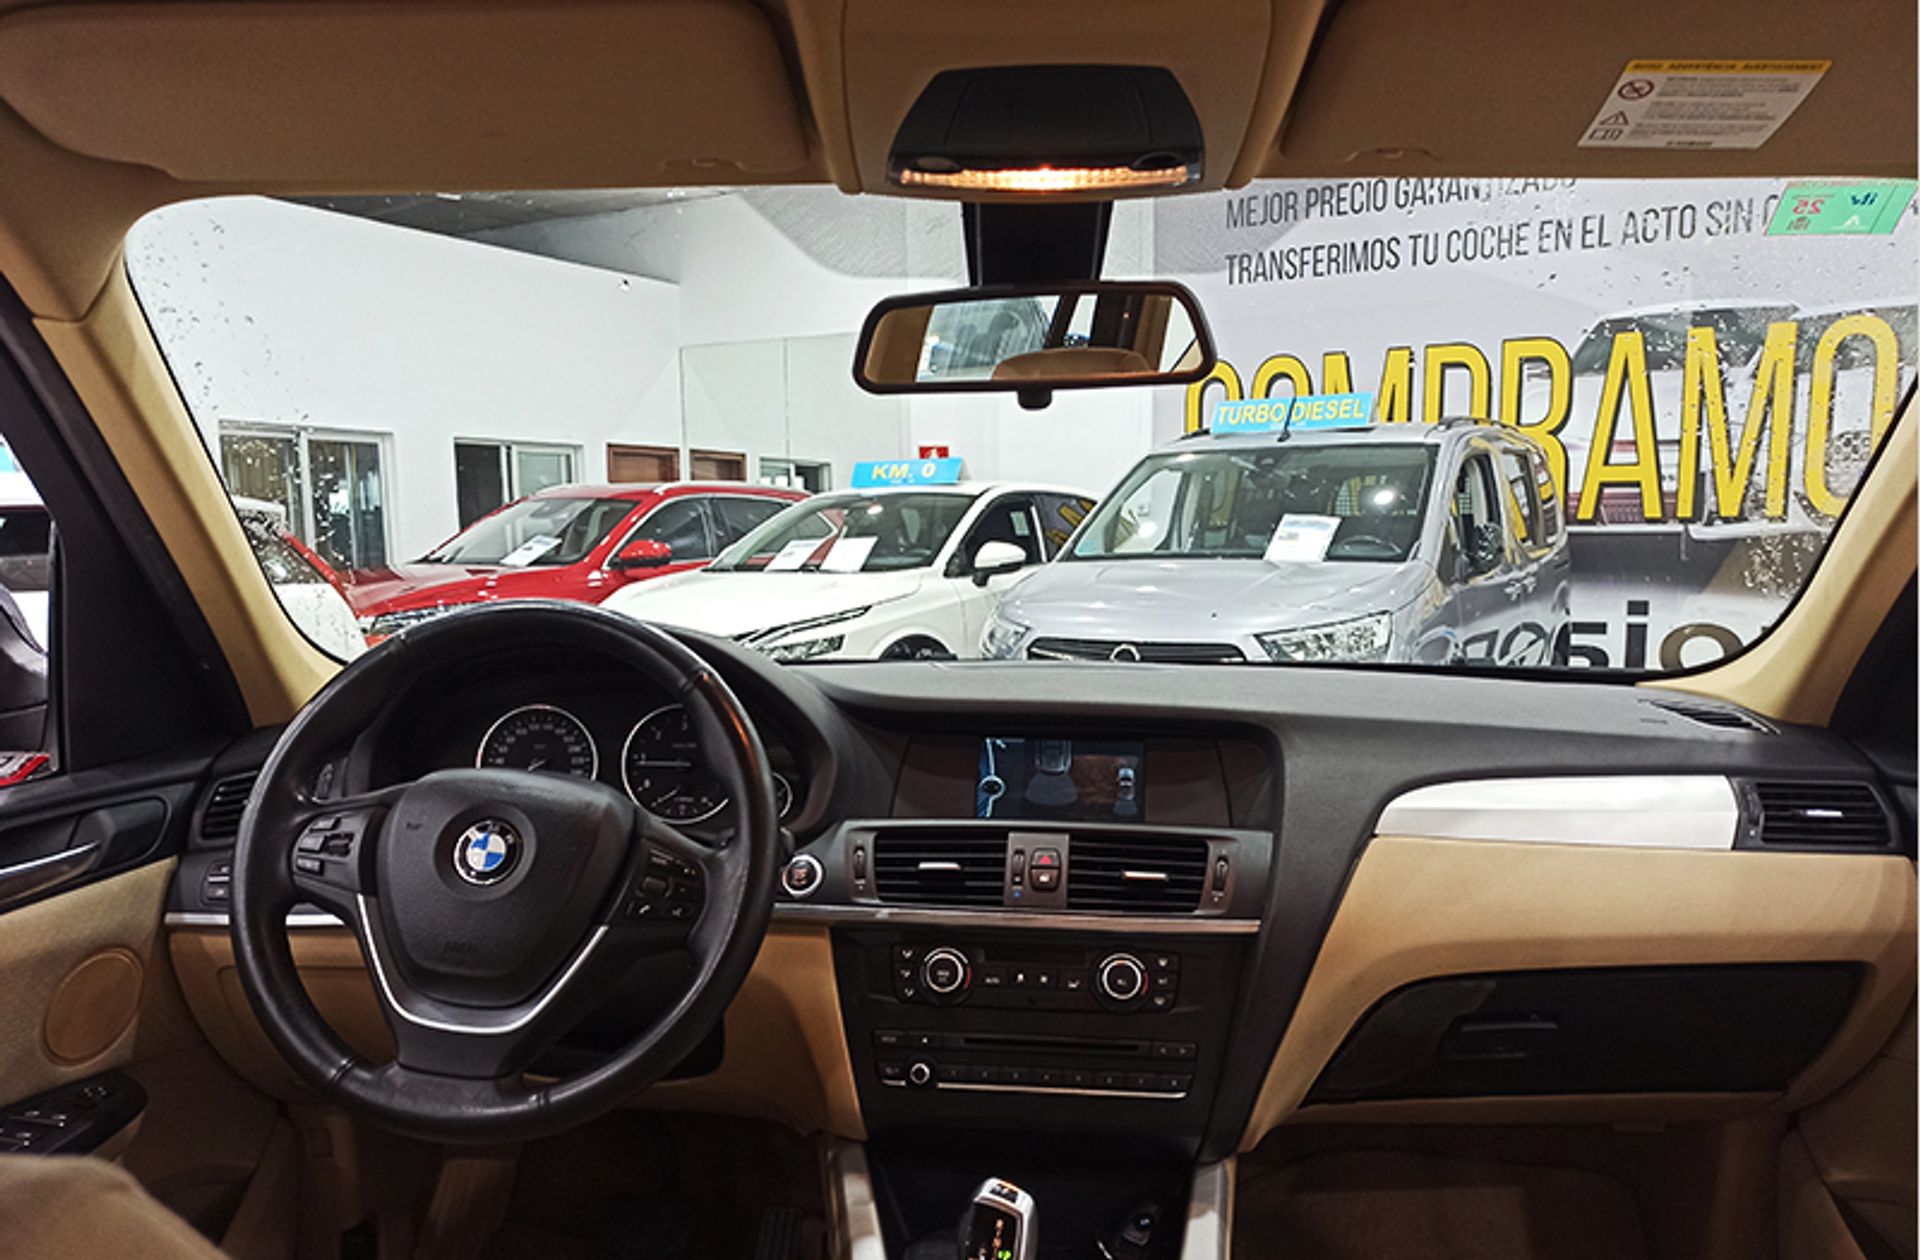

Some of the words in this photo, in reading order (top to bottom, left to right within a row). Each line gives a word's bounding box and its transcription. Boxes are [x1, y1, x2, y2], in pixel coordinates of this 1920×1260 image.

[1226, 190, 1298, 229] MEJOR
[1305, 179, 1388, 219] PRECIO
[1225, 236, 1401, 285] TRANSFERIMOS
[1409, 233, 1439, 266] TU
[1446, 224, 1530, 263] COCHE
[1538, 219, 1572, 253] EN
[1581, 213, 1612, 249] EL
[1621, 204, 1697, 245] ACTO
[1706, 197, 1753, 236] SIN
[1218, 403, 1287, 425] TURBO
[1291, 399, 1365, 422] DIESEL
